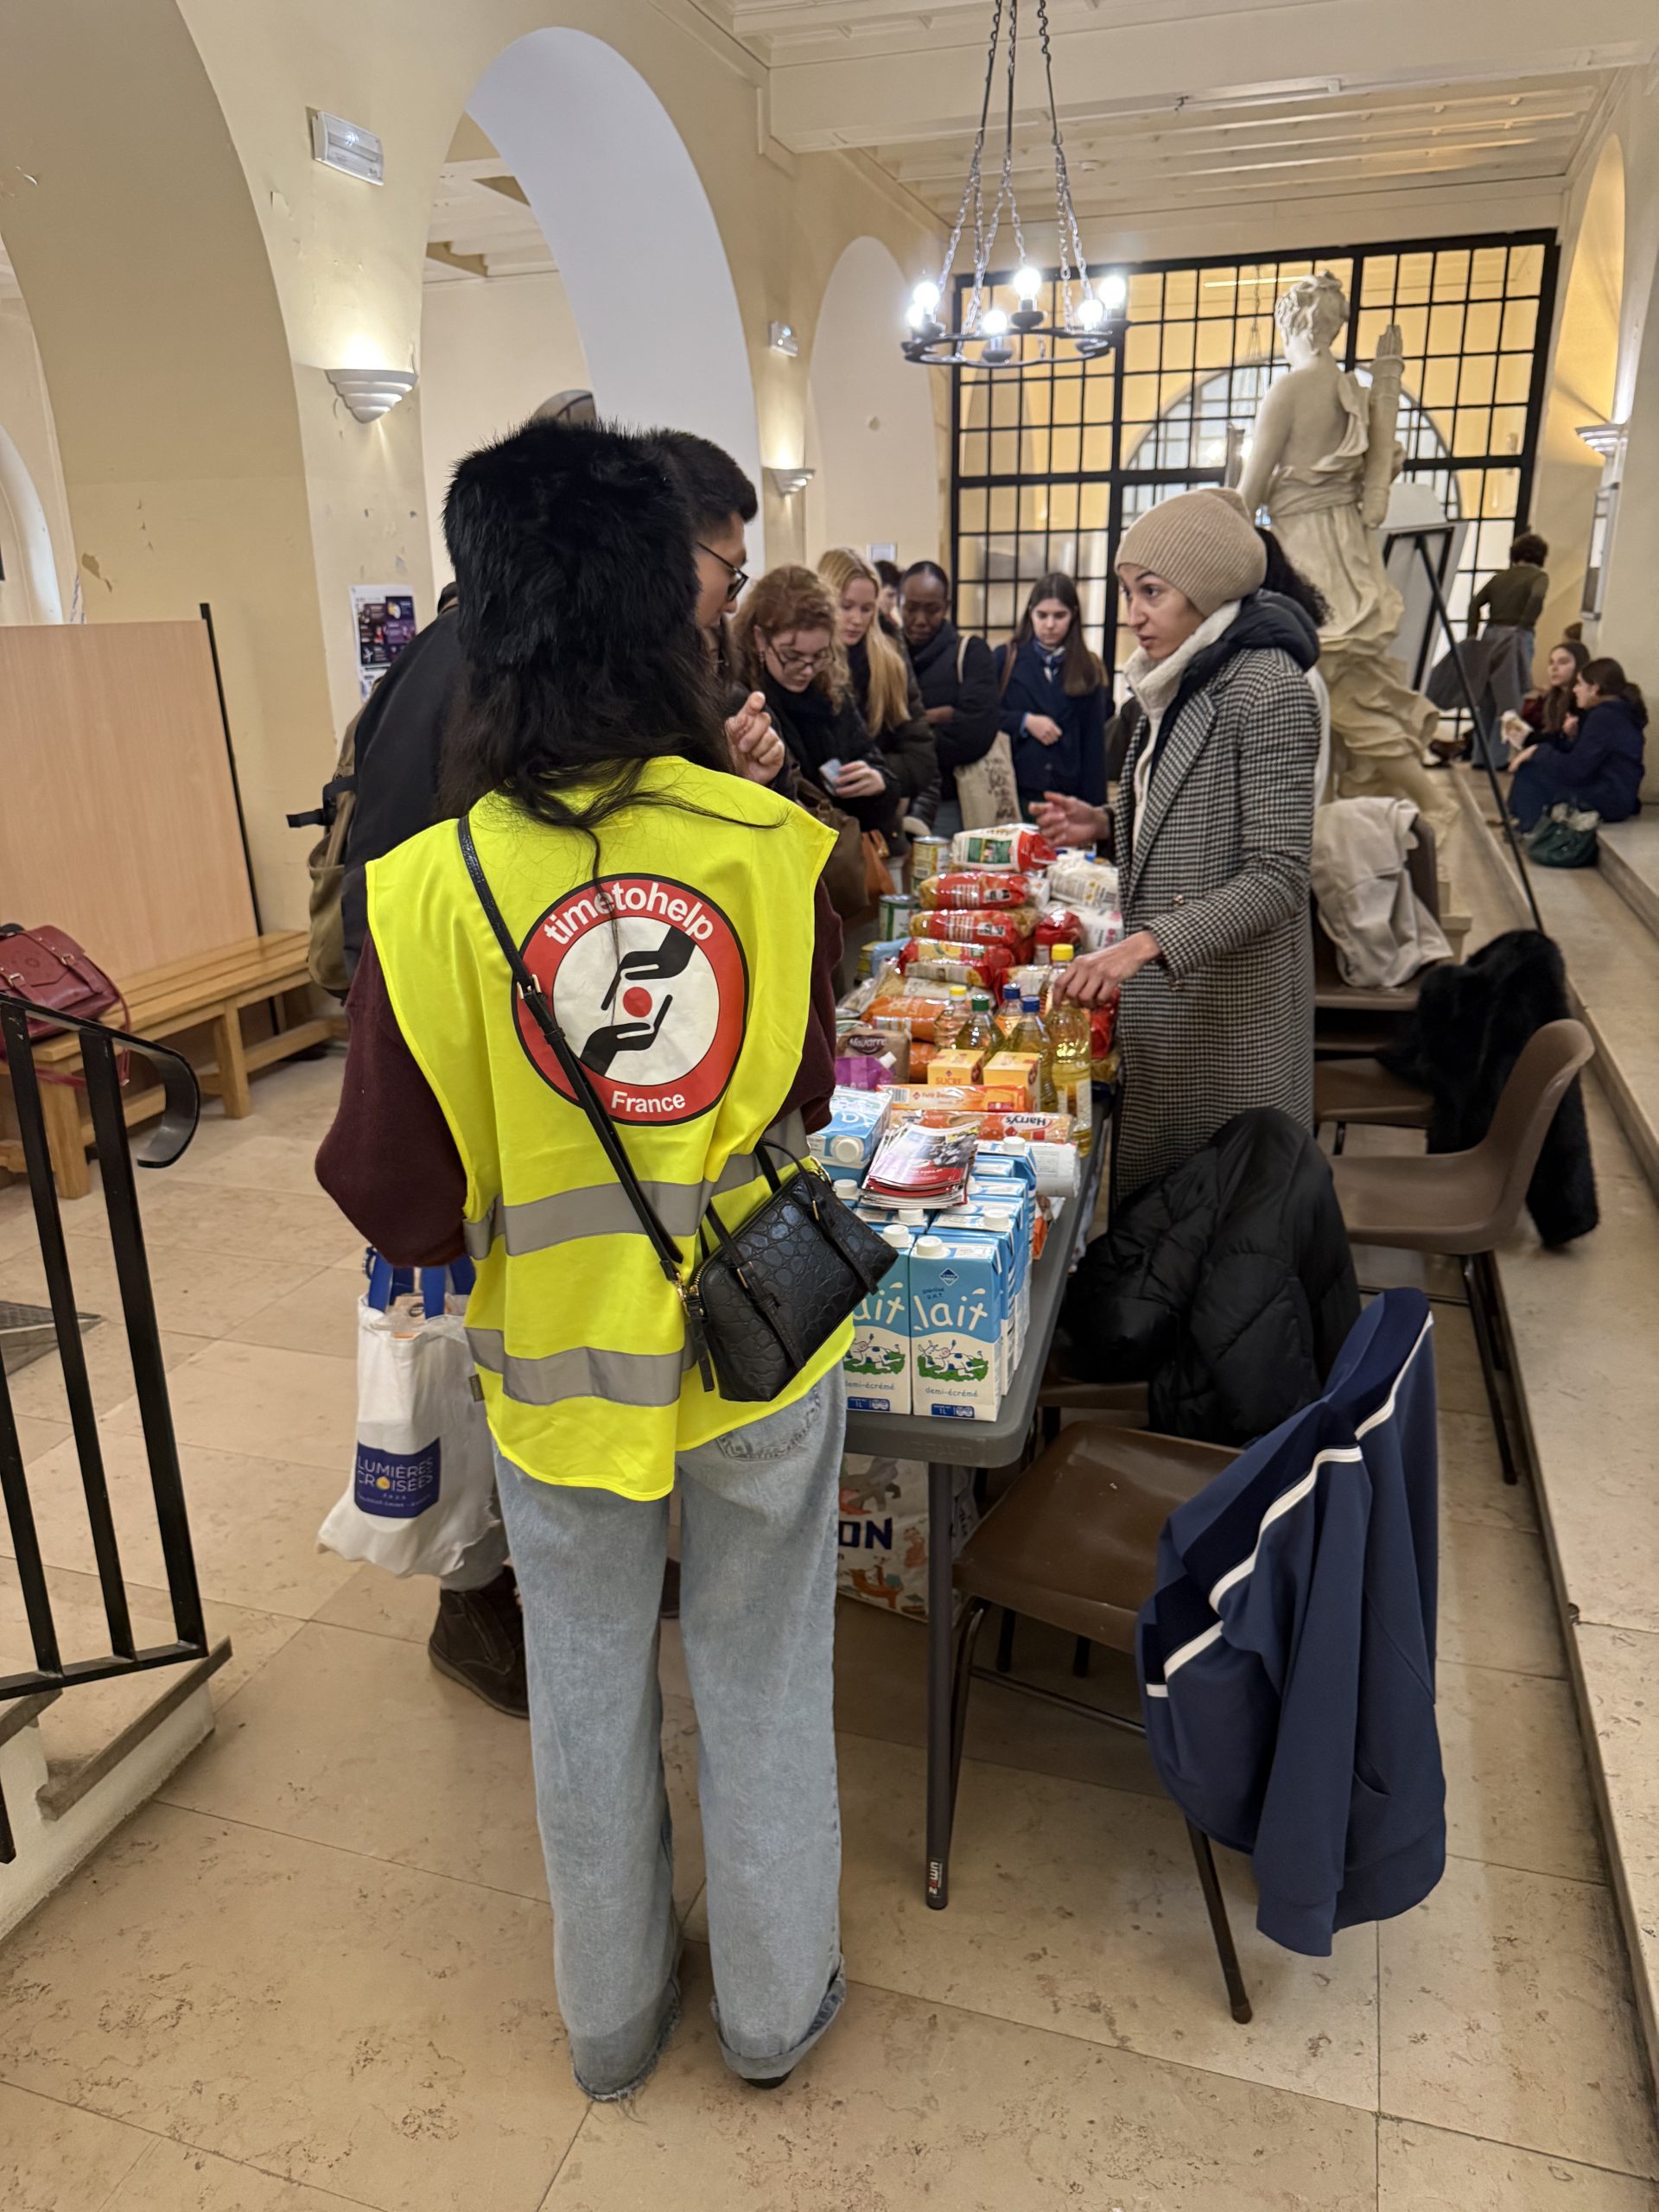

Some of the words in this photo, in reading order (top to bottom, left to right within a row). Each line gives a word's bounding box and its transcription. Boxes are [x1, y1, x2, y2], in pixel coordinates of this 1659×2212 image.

[543, 882, 714, 944] timetohelp
[611, 1090, 686, 1113] France
[1005, 1115, 1047, 1127] Harry's
[913, 1294, 988, 1332] lait
[925, 1386, 978, 1397] demi-écrémé
